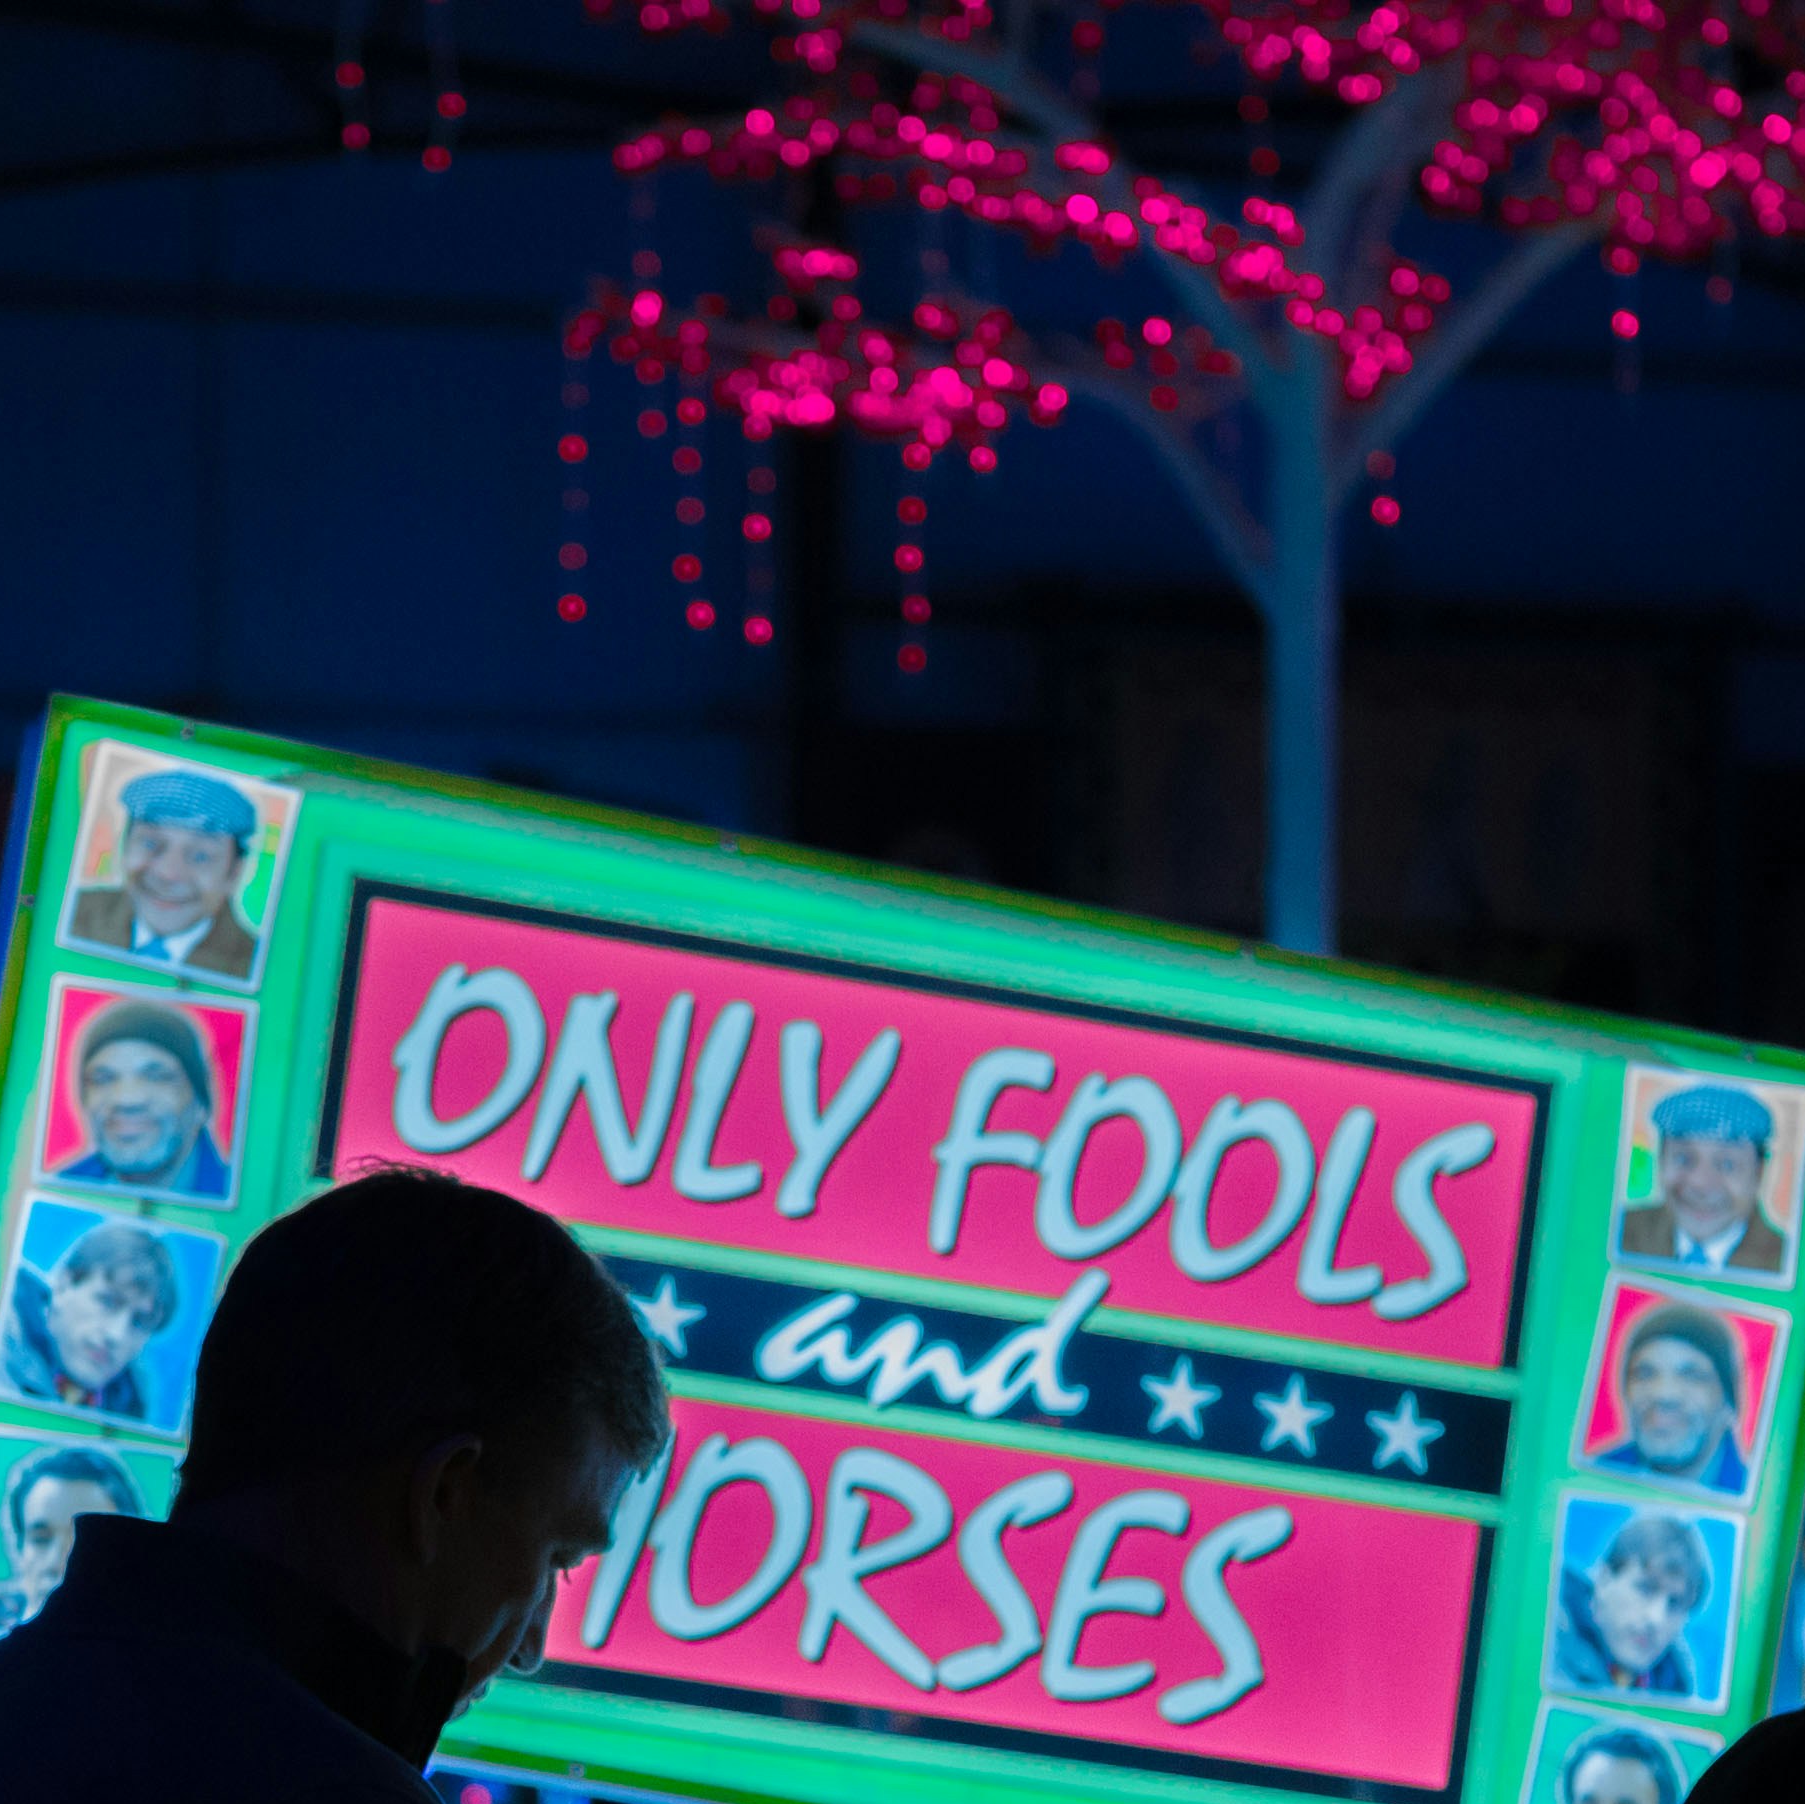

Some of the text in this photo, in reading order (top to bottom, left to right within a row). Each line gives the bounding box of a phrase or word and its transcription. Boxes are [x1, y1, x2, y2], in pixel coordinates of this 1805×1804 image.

[392, 961, 1499, 1322] ONLY FOOLS
[756, 1268, 1113, 1418] and
